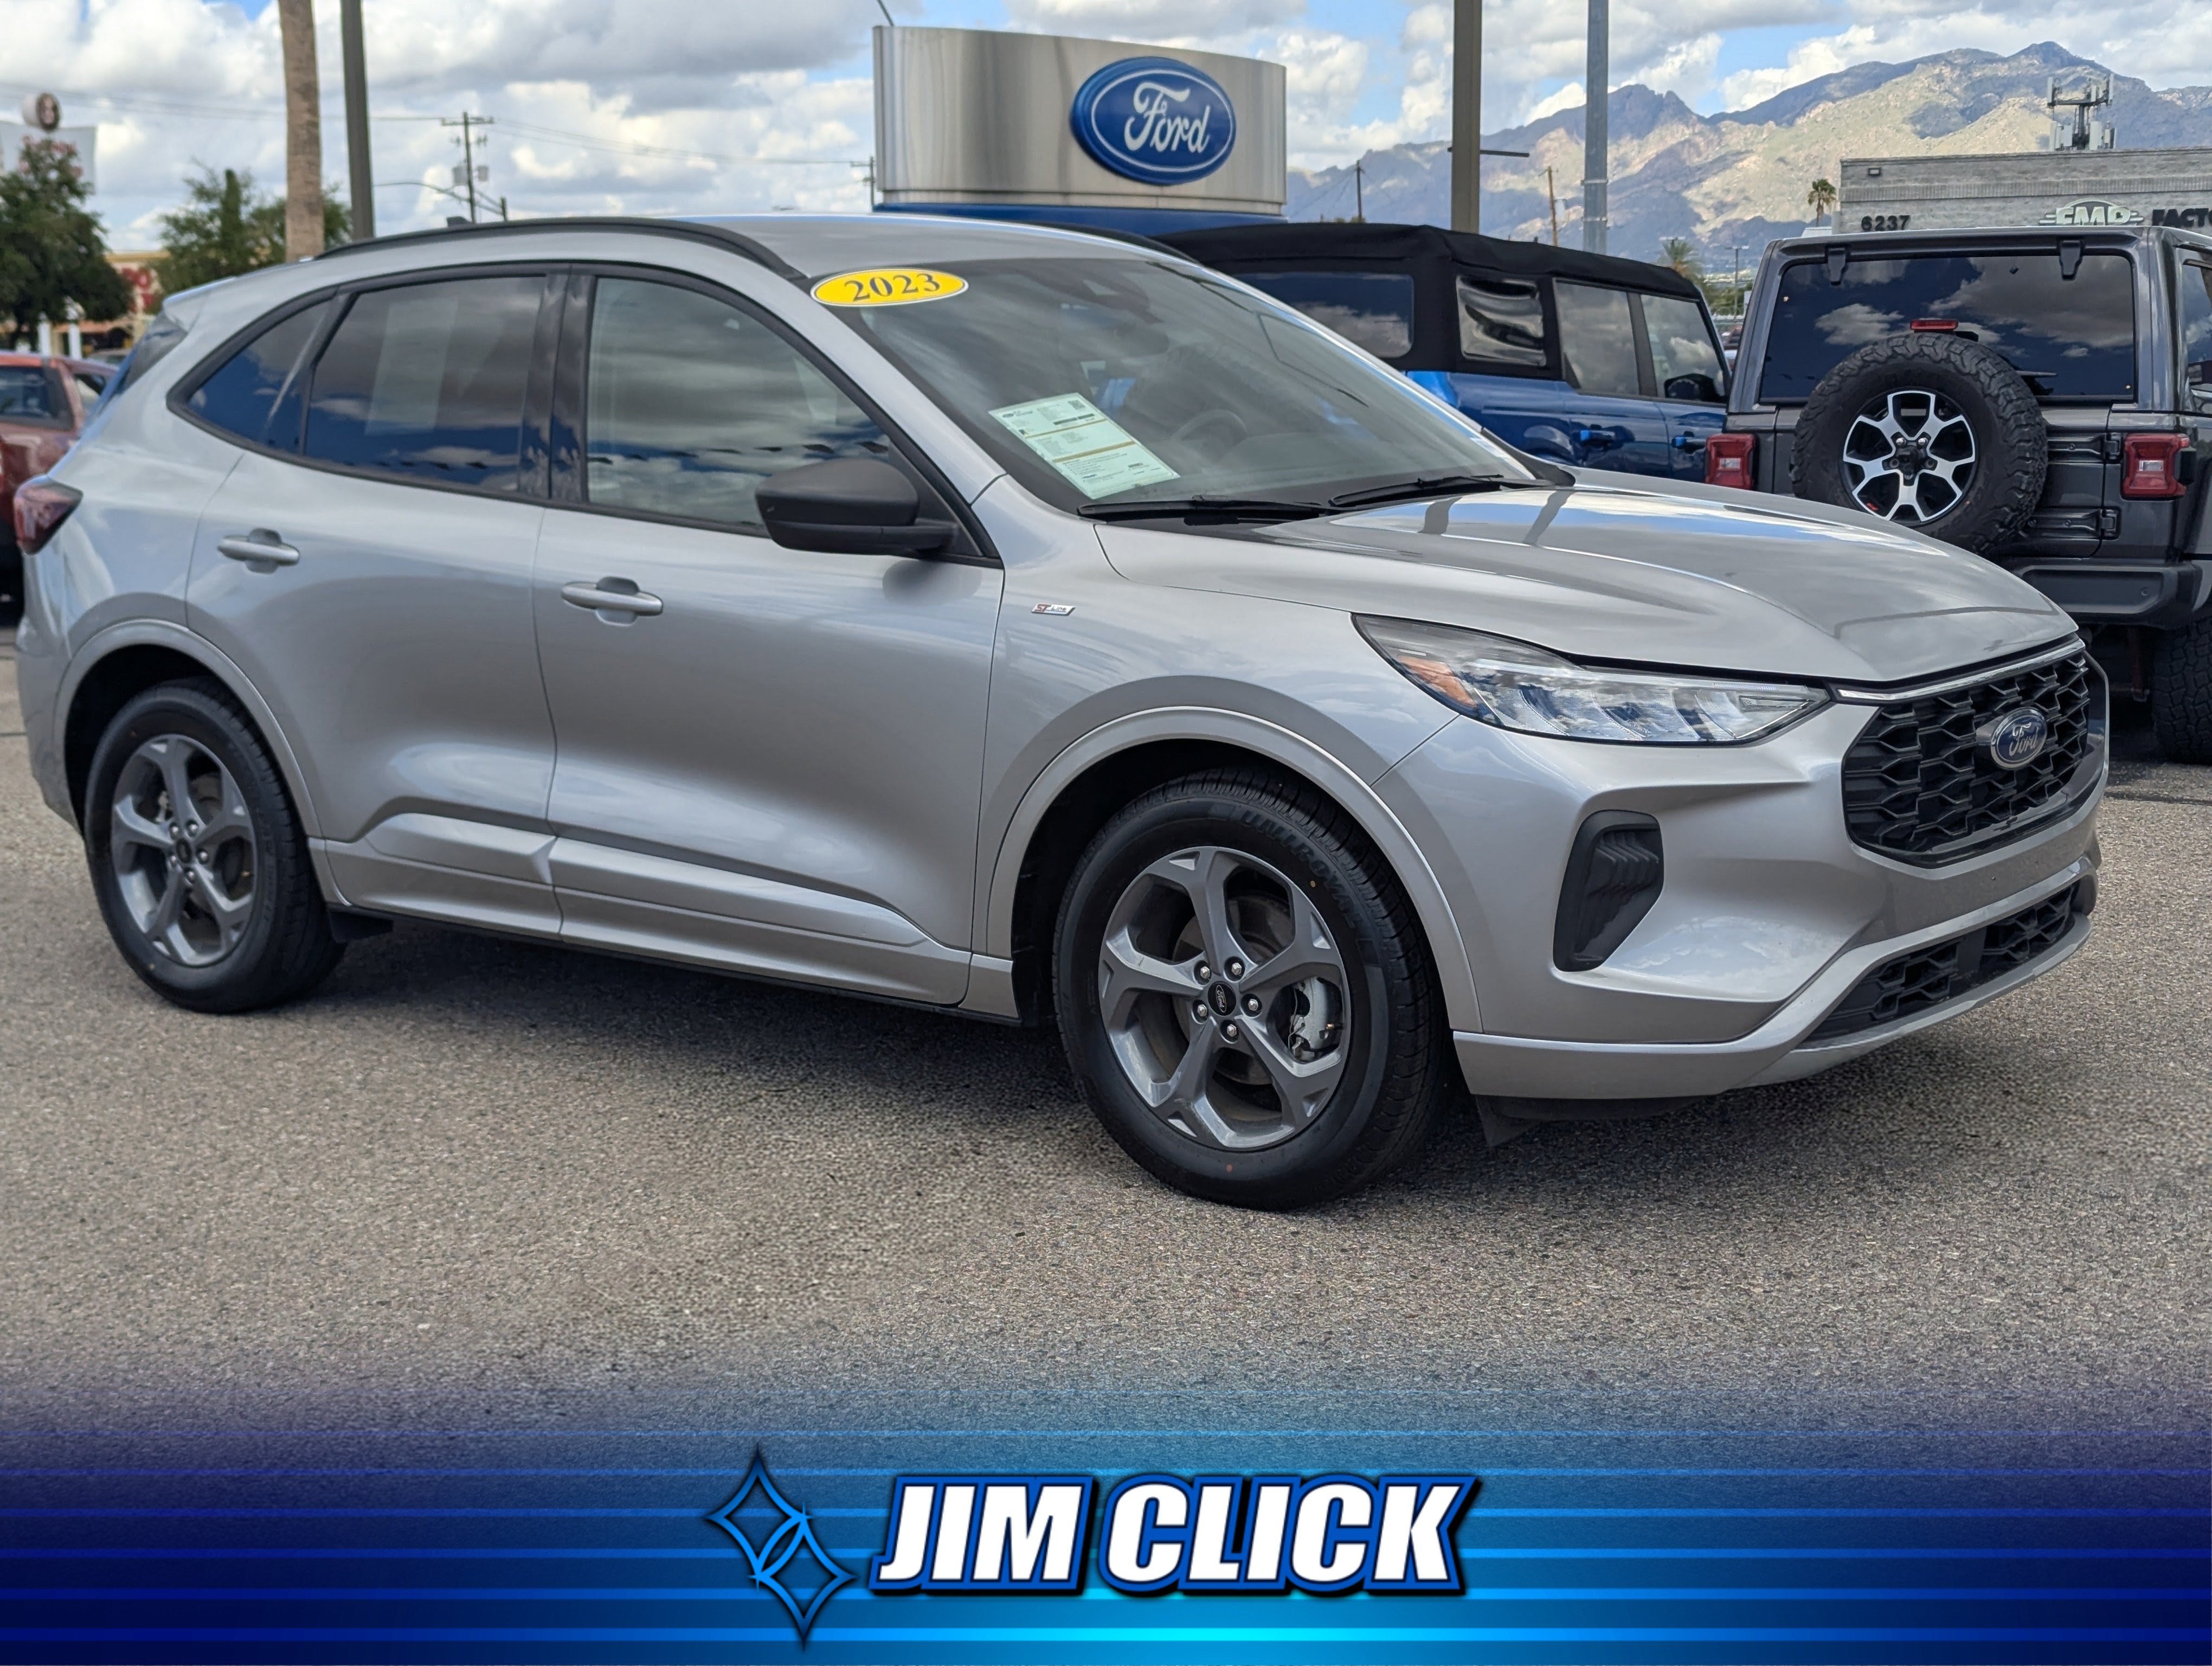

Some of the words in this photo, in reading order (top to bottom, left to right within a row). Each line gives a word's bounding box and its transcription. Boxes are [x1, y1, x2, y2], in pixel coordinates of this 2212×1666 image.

[1124, 82, 1210, 153] Ford
[1861, 215, 1910, 232] 6237
[2152, 208, 2212, 228] FACT
[844, 273, 940, 302] 2023
[2009, 722, 2039, 757] Ford
